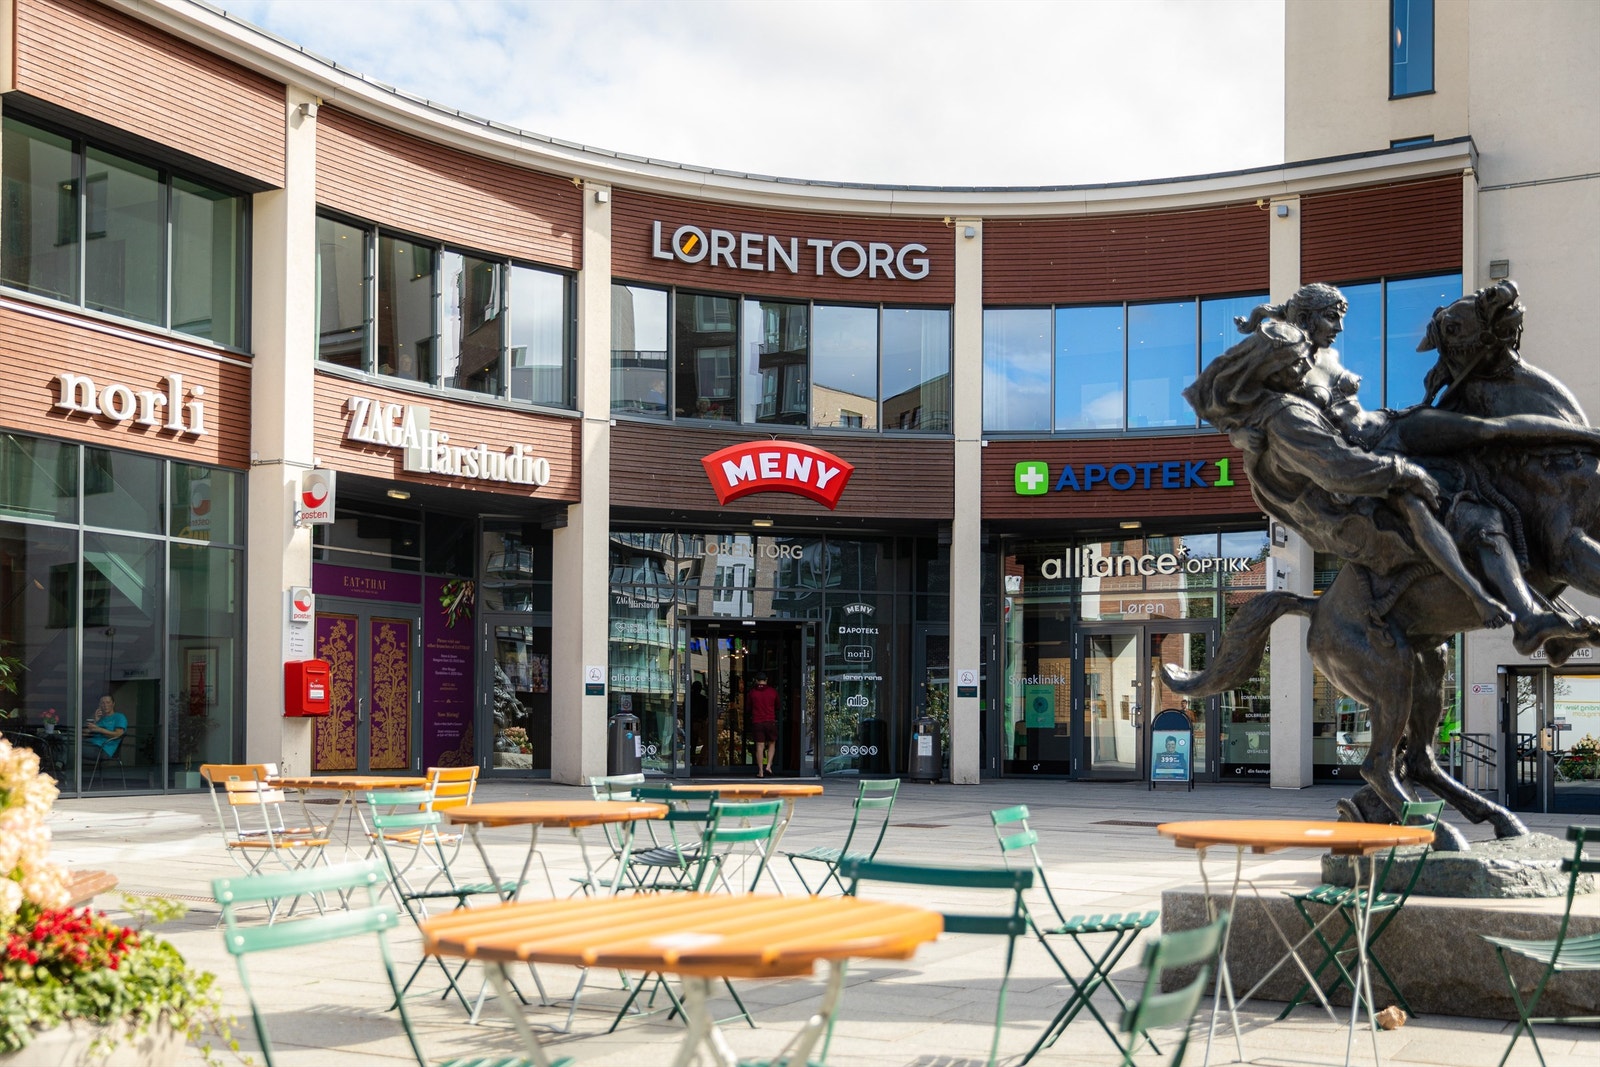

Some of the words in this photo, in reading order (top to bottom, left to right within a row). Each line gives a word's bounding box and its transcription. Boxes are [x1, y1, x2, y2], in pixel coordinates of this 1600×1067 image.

[653, 220, 799, 274] LØREN
[807, 239, 930, 281] TORG
[54, 373, 209, 435] norli
[347, 397, 421, 449] ZAGA
[419, 428, 551, 487] Hårstudio
[721, 452, 841, 490] MENY
[1055, 460, 1209, 492] APOTEK
[1213, 457, 1235, 487] 1
[301, 510, 328, 520] posten
[758, 543, 804, 560] TORG
[1187, 556, 1251, 574] OPTIKK
[343, 575, 361, 588] EAT
[364, 578, 386, 590] THAI
[846, 605, 873, 614] MENY
[1119, 600, 1165, 614] Løren
[847, 649, 870, 658] norli
[1008, 674, 1067, 686] Synsklinikk
[847, 695, 869, 707] nille
